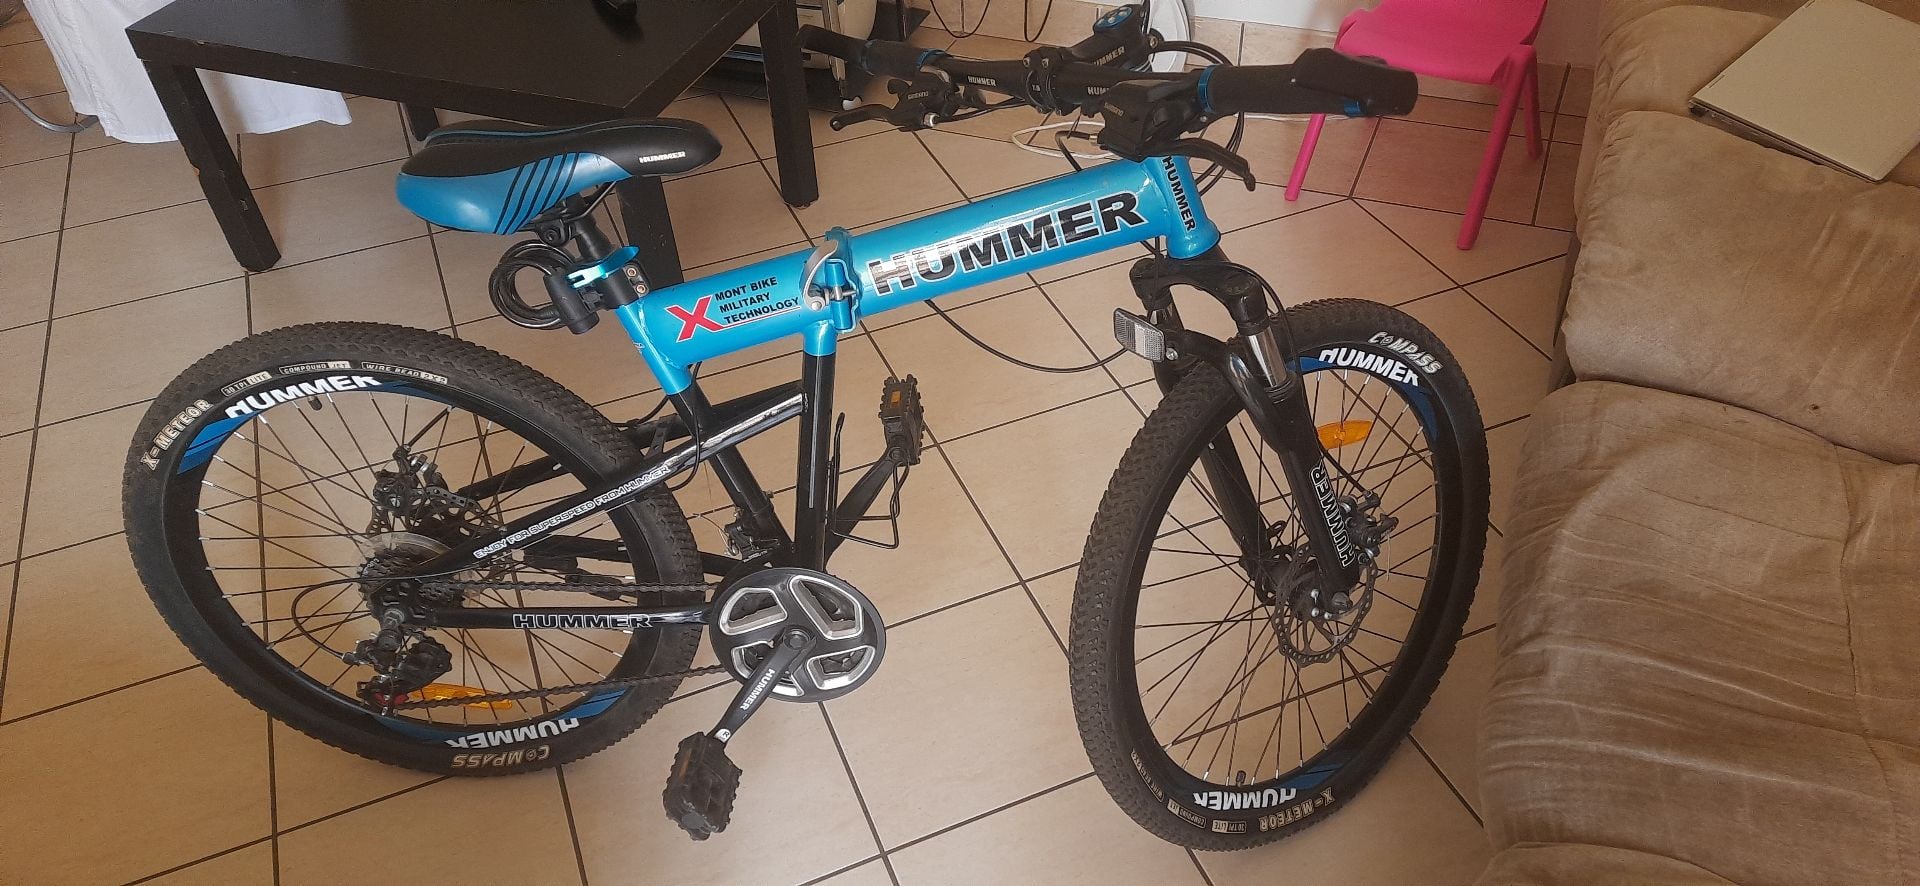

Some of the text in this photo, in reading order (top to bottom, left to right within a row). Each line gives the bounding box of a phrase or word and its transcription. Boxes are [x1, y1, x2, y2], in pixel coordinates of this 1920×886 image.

[1093, 46, 1125, 66] UMMER
[967, 75, 997, 87] HUMMER
[1087, 86, 1109, 95] HUM
[639, 151, 686, 164] HUMMER
[1162, 155, 1196, 232] HUMMER
[866, 191, 1148, 297] HUMMER
[715, 277, 778, 301] MONT BIKE
[719, 292, 771, 313] MILITARY
[723, 297, 799, 324] TECHNOLOGY
[1368, 331, 1443, 374] COMPASS
[283, 363, 327, 374] COMPOUND
[366, 363, 392, 372] WIRE
[1319, 347, 1419, 387] HUMMER
[224, 374, 269, 395] 30 TPI LITE
[225, 376, 382, 418] HUMMER
[141, 399, 214, 471] X-METEOR
[473, 465, 671, 558] ENJOY FOR SUPERSPEED FROM HUMMER
[1310, 458, 1356, 568] HUMMER
[512, 614, 653, 629] HUMMER
[740, 668, 776, 711] HUMMER
[444, 718, 580, 749] HUMMER
[452, 745, 551, 768] COMPASS
[1194, 788, 1296, 811] HUMMER
[1259, 787, 1335, 832] X-METEOR
[1180, 808, 1205, 826] COMPOUND
